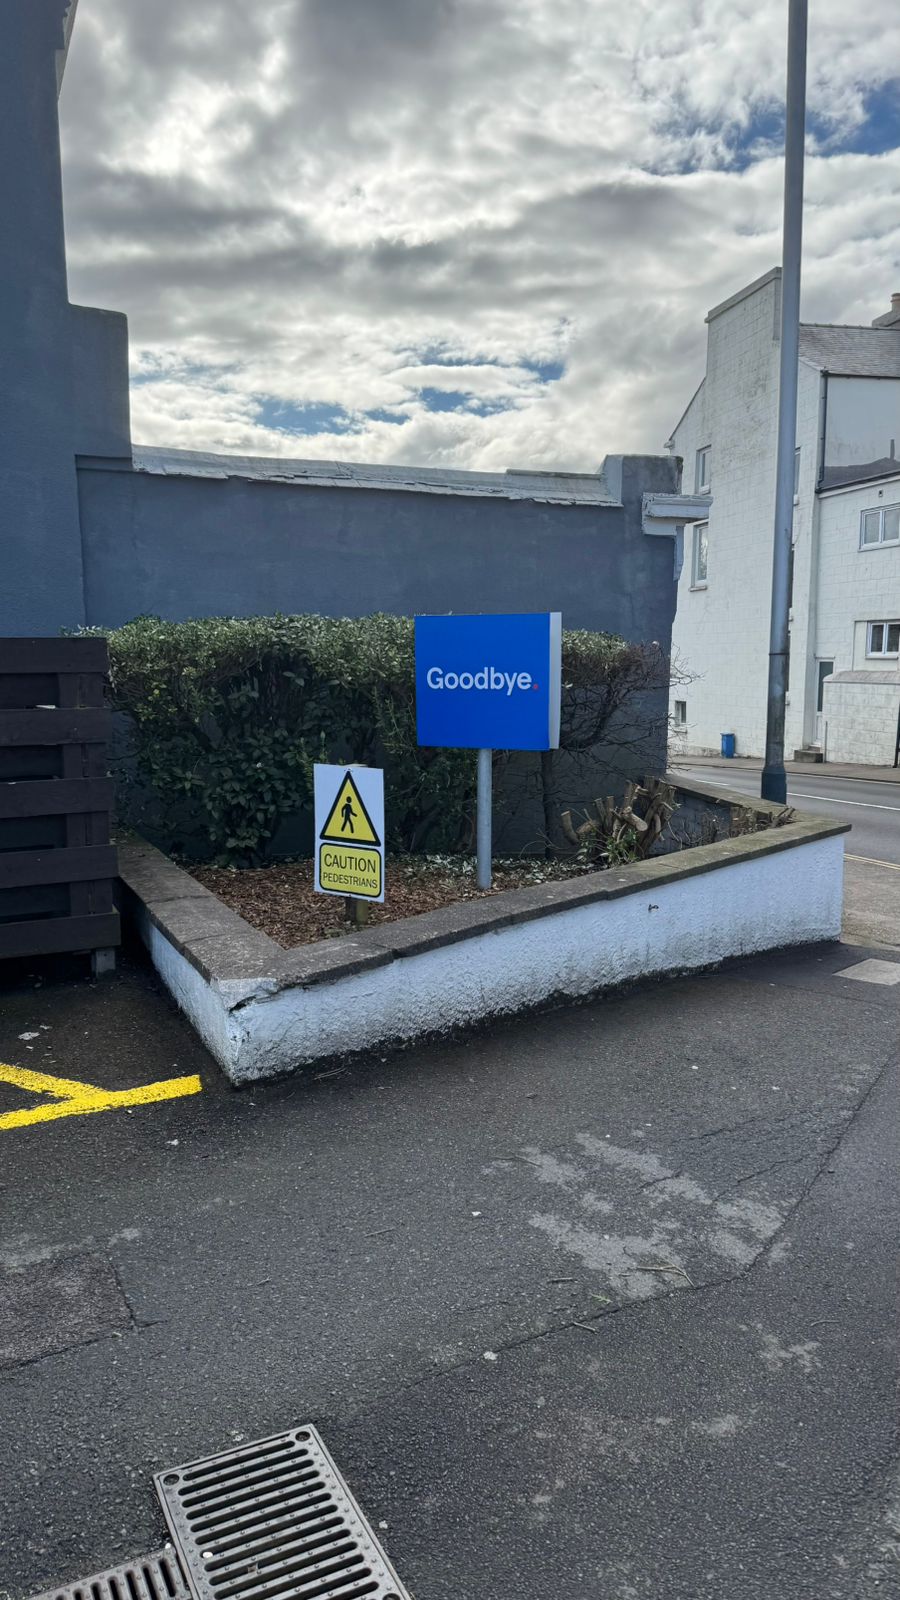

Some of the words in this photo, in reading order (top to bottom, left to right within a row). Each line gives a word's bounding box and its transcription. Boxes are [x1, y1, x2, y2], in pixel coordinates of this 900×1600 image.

[426, 666, 538, 696] Goodbye.
[324, 853, 376, 873] CAUTION
[323, 872, 378, 889] PEDESTRIANS
